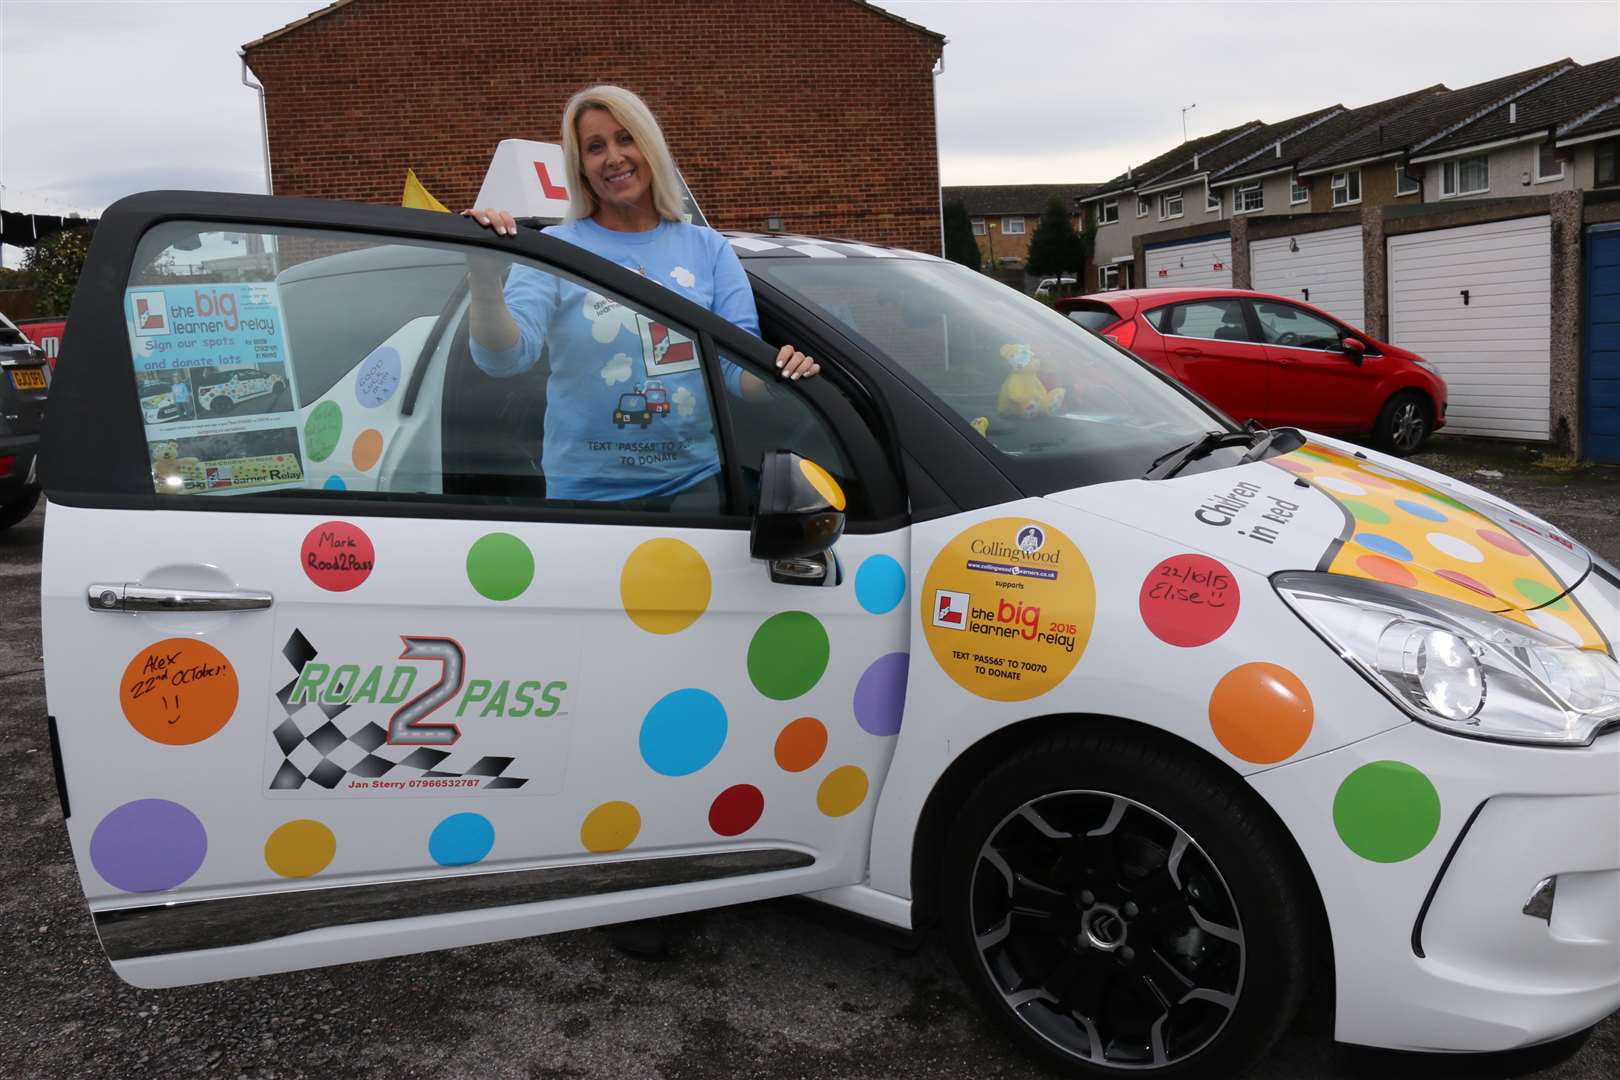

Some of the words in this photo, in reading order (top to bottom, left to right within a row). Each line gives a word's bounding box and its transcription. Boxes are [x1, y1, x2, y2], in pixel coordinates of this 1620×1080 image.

[533, 160, 570, 200] L
[171, 305, 195, 318] the
[195, 289, 240, 332] big
[173, 321, 225, 335] learner
[240, 318, 275, 336] relay
[145, 340, 173, 353] Sign
[176, 339, 198, 350] our
[203, 337, 235, 350] spots
[144, 360, 166, 371] and
[172, 357, 215, 368] donate
[219, 355, 241, 366] lots
[589, 441, 611, 451] TEXT
[661, 442, 674, 451] TO
[621, 456, 635, 465] TO
[639, 453, 677, 465] DONATE
[319, 531, 356, 547] Mark
[308, 552, 373, 571] Road2Pass
[970, 538, 1060, 564] Collingwood
[995, 581, 1024, 590] supports
[1161, 565, 1228, 590] 22/10/15
[1149, 582, 1203, 604] Elise
[971, 607, 994, 621] the
[997, 598, 1040, 641] big
[969, 621, 1020, 638] learner
[1037, 631, 1075, 653] relay
[142, 651, 182, 676] Alex
[952, 650, 970, 661] TEXT
[1007, 659, 1019, 668] TO
[1021, 661, 1047, 673] 70070
[975, 665, 985, 675] TO
[988, 668, 1021, 680] DONATE
[130, 669, 168, 699] 22nd
[288, 662, 418, 705] ROAD
[455, 680, 567, 717] PASS
[348, 780, 368, 789] Jan
[372, 780, 406, 789] Sterry
[408, 779, 480, 788] 07966532787
